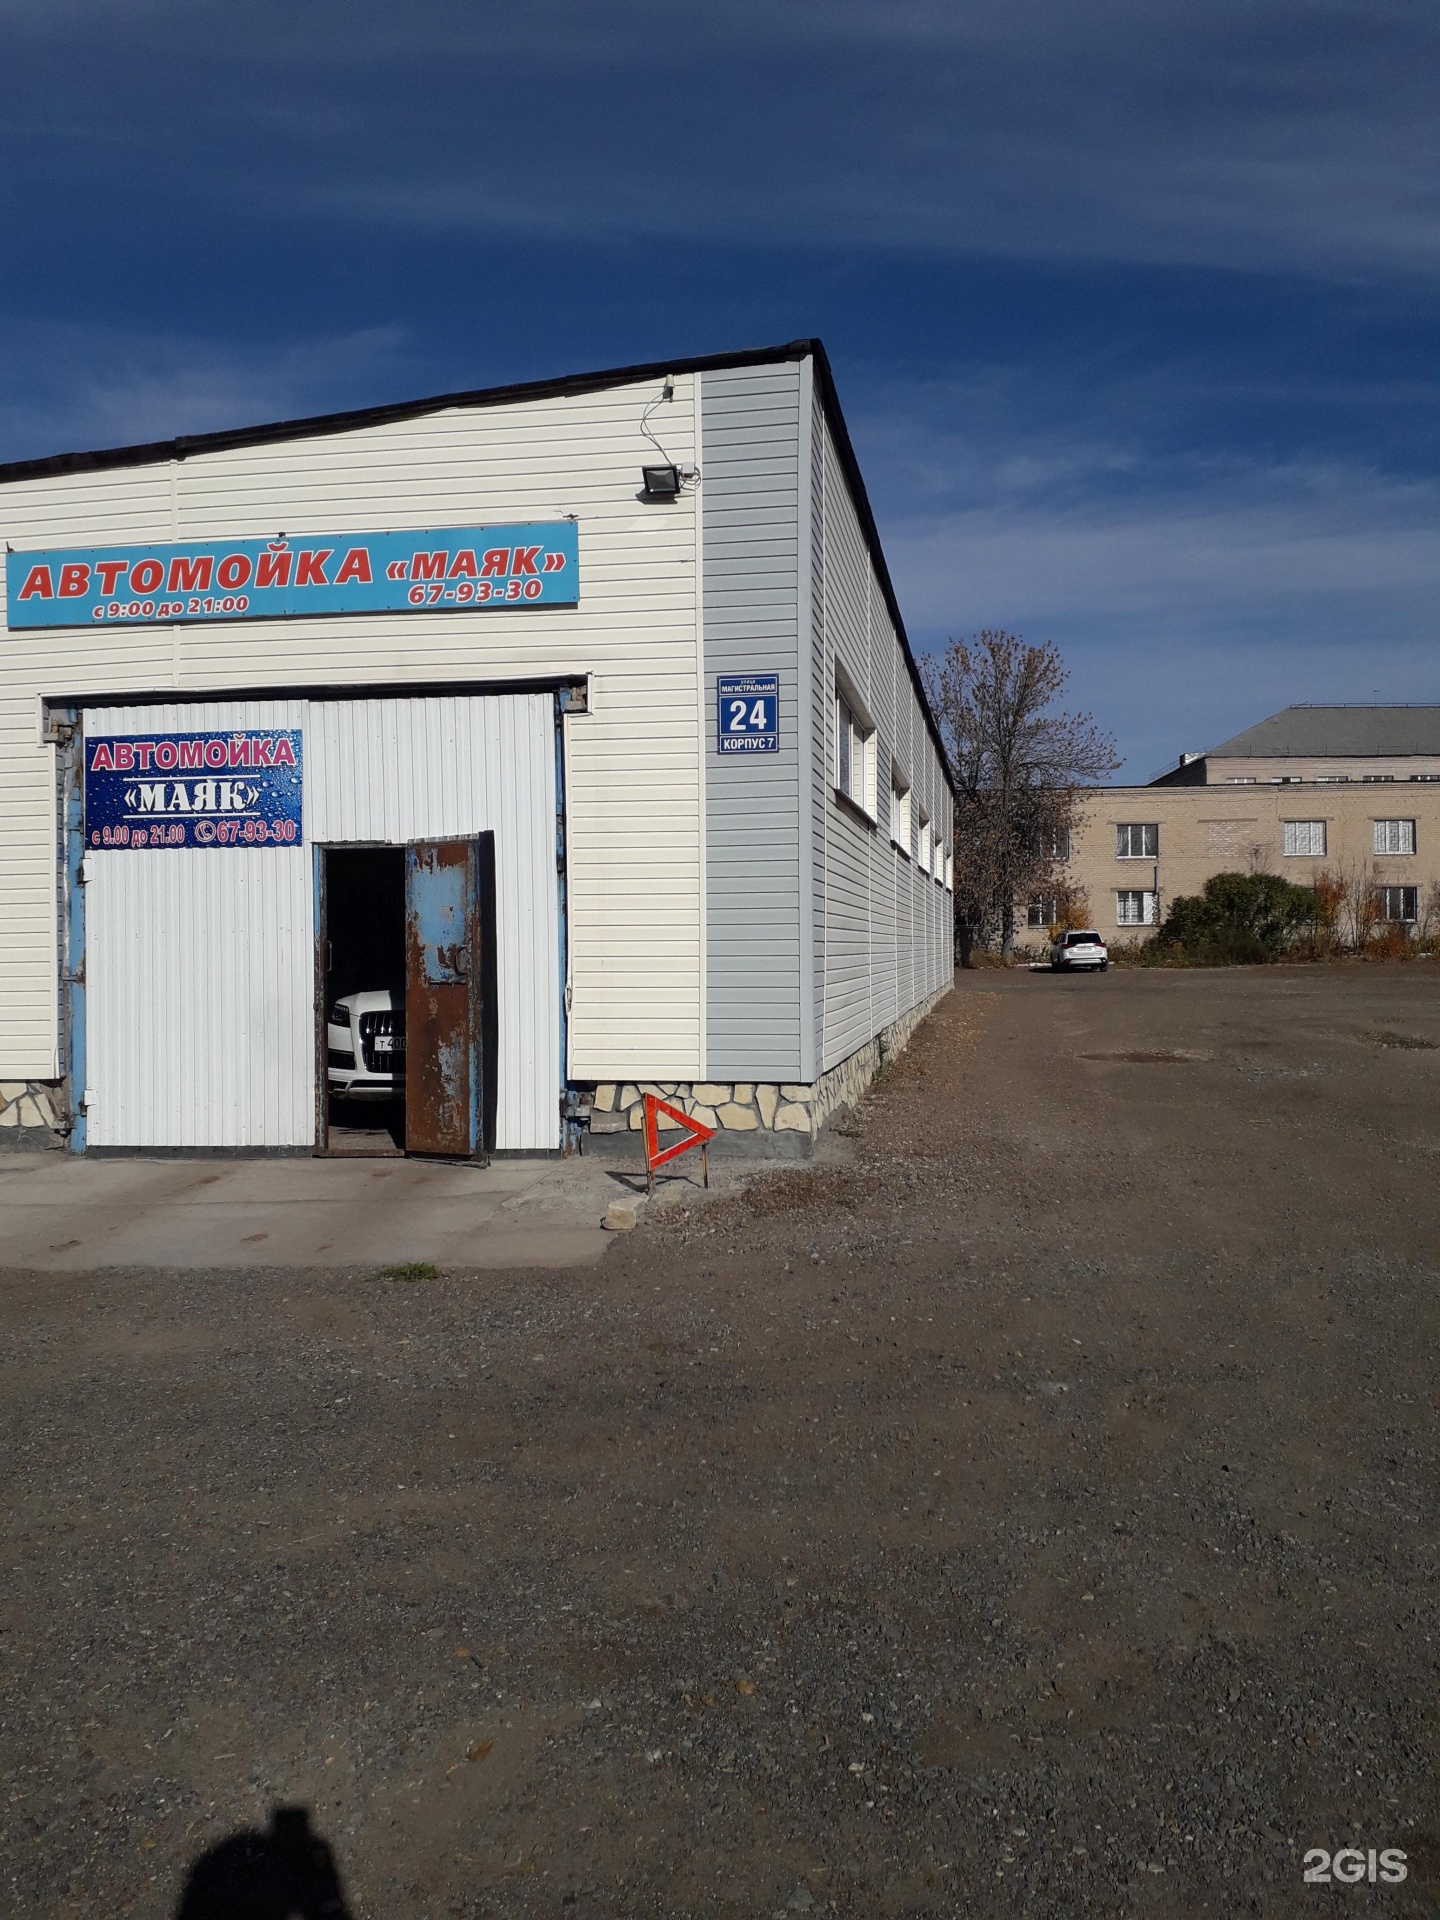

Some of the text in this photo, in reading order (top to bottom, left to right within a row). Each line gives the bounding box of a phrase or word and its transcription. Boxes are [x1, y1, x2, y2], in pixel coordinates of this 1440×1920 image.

[17, 541, 567, 600] АВТОМОЙКА «МАЯК»
[408, 578, 543, 605] 67-93-30
[93, 596, 249, 618] с 9:00 до 21:00
[721, 684, 775, 692] МАГИСТРАЛЬНАЯ
[730, 700, 767, 731] 24
[91, 734, 296, 771] АВТОМОЙКА
[724, 738, 774, 750] КОРПУС 7
[124, 781, 260, 812] «МАЯК»
[92, 820, 296, 848] с 9.00 до 21.00 67-93-30
